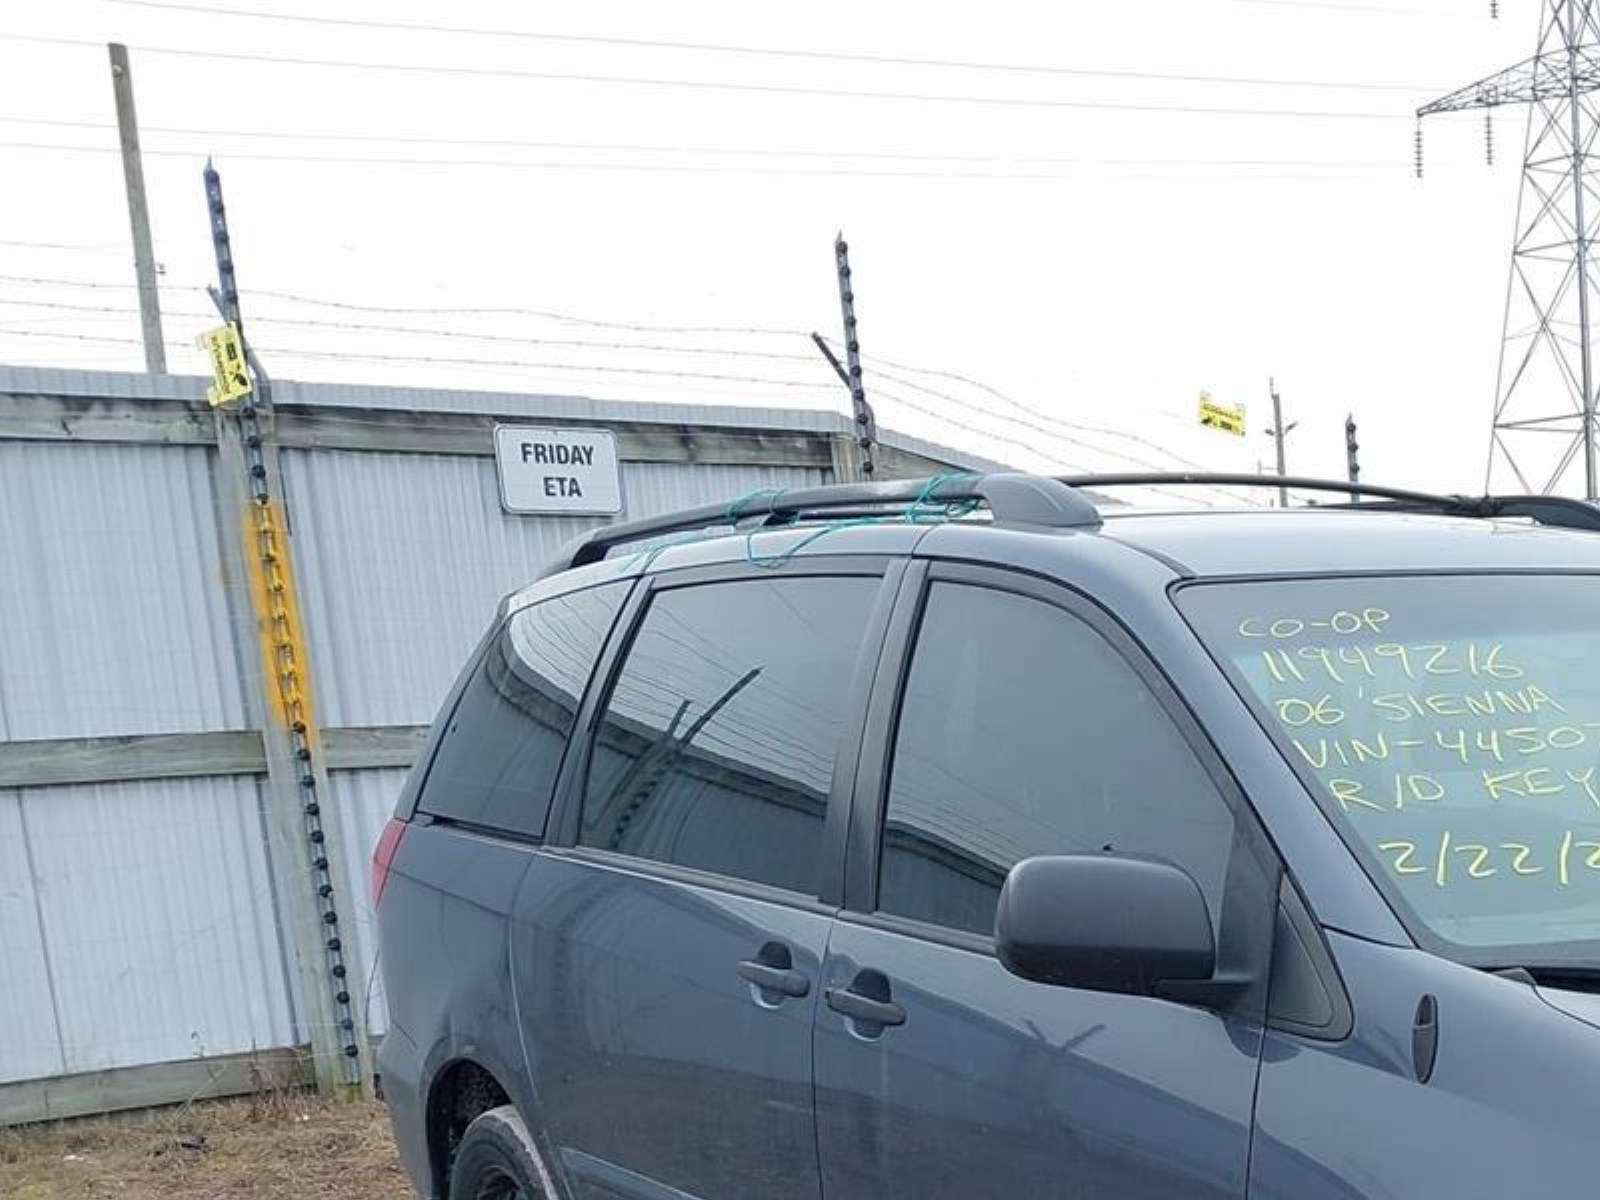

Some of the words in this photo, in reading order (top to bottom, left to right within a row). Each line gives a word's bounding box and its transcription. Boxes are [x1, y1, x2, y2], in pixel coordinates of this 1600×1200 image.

[520, 443, 594, 466] FRIDAY
[543, 477, 582, 498] ETA
[1238, 608, 1391, 639] CO-OP
[1262, 642, 1524, 684] 11949216
